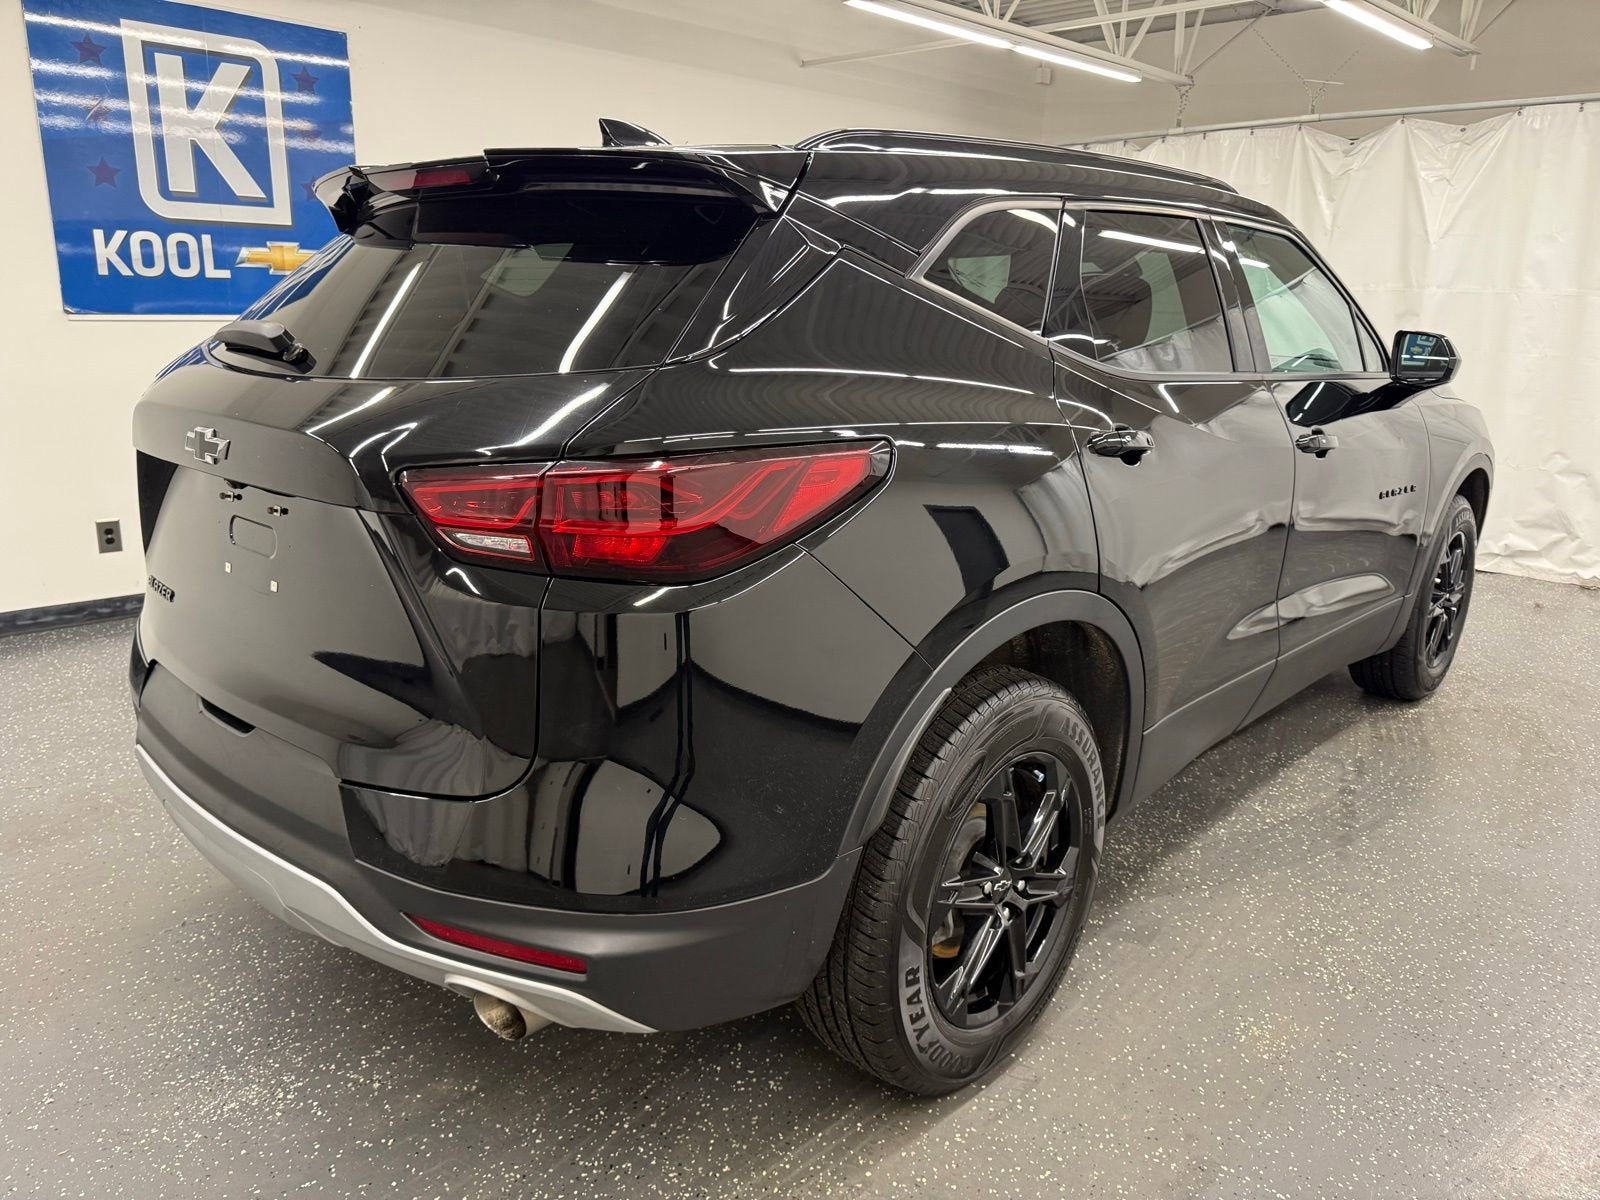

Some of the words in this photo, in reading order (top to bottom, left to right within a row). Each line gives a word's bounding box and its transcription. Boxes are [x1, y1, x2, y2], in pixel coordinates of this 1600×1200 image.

[152, 52, 268, 199] K
[93, 228, 232, 279] KOOL
[1058, 716, 1105, 831] ASSURANCE
